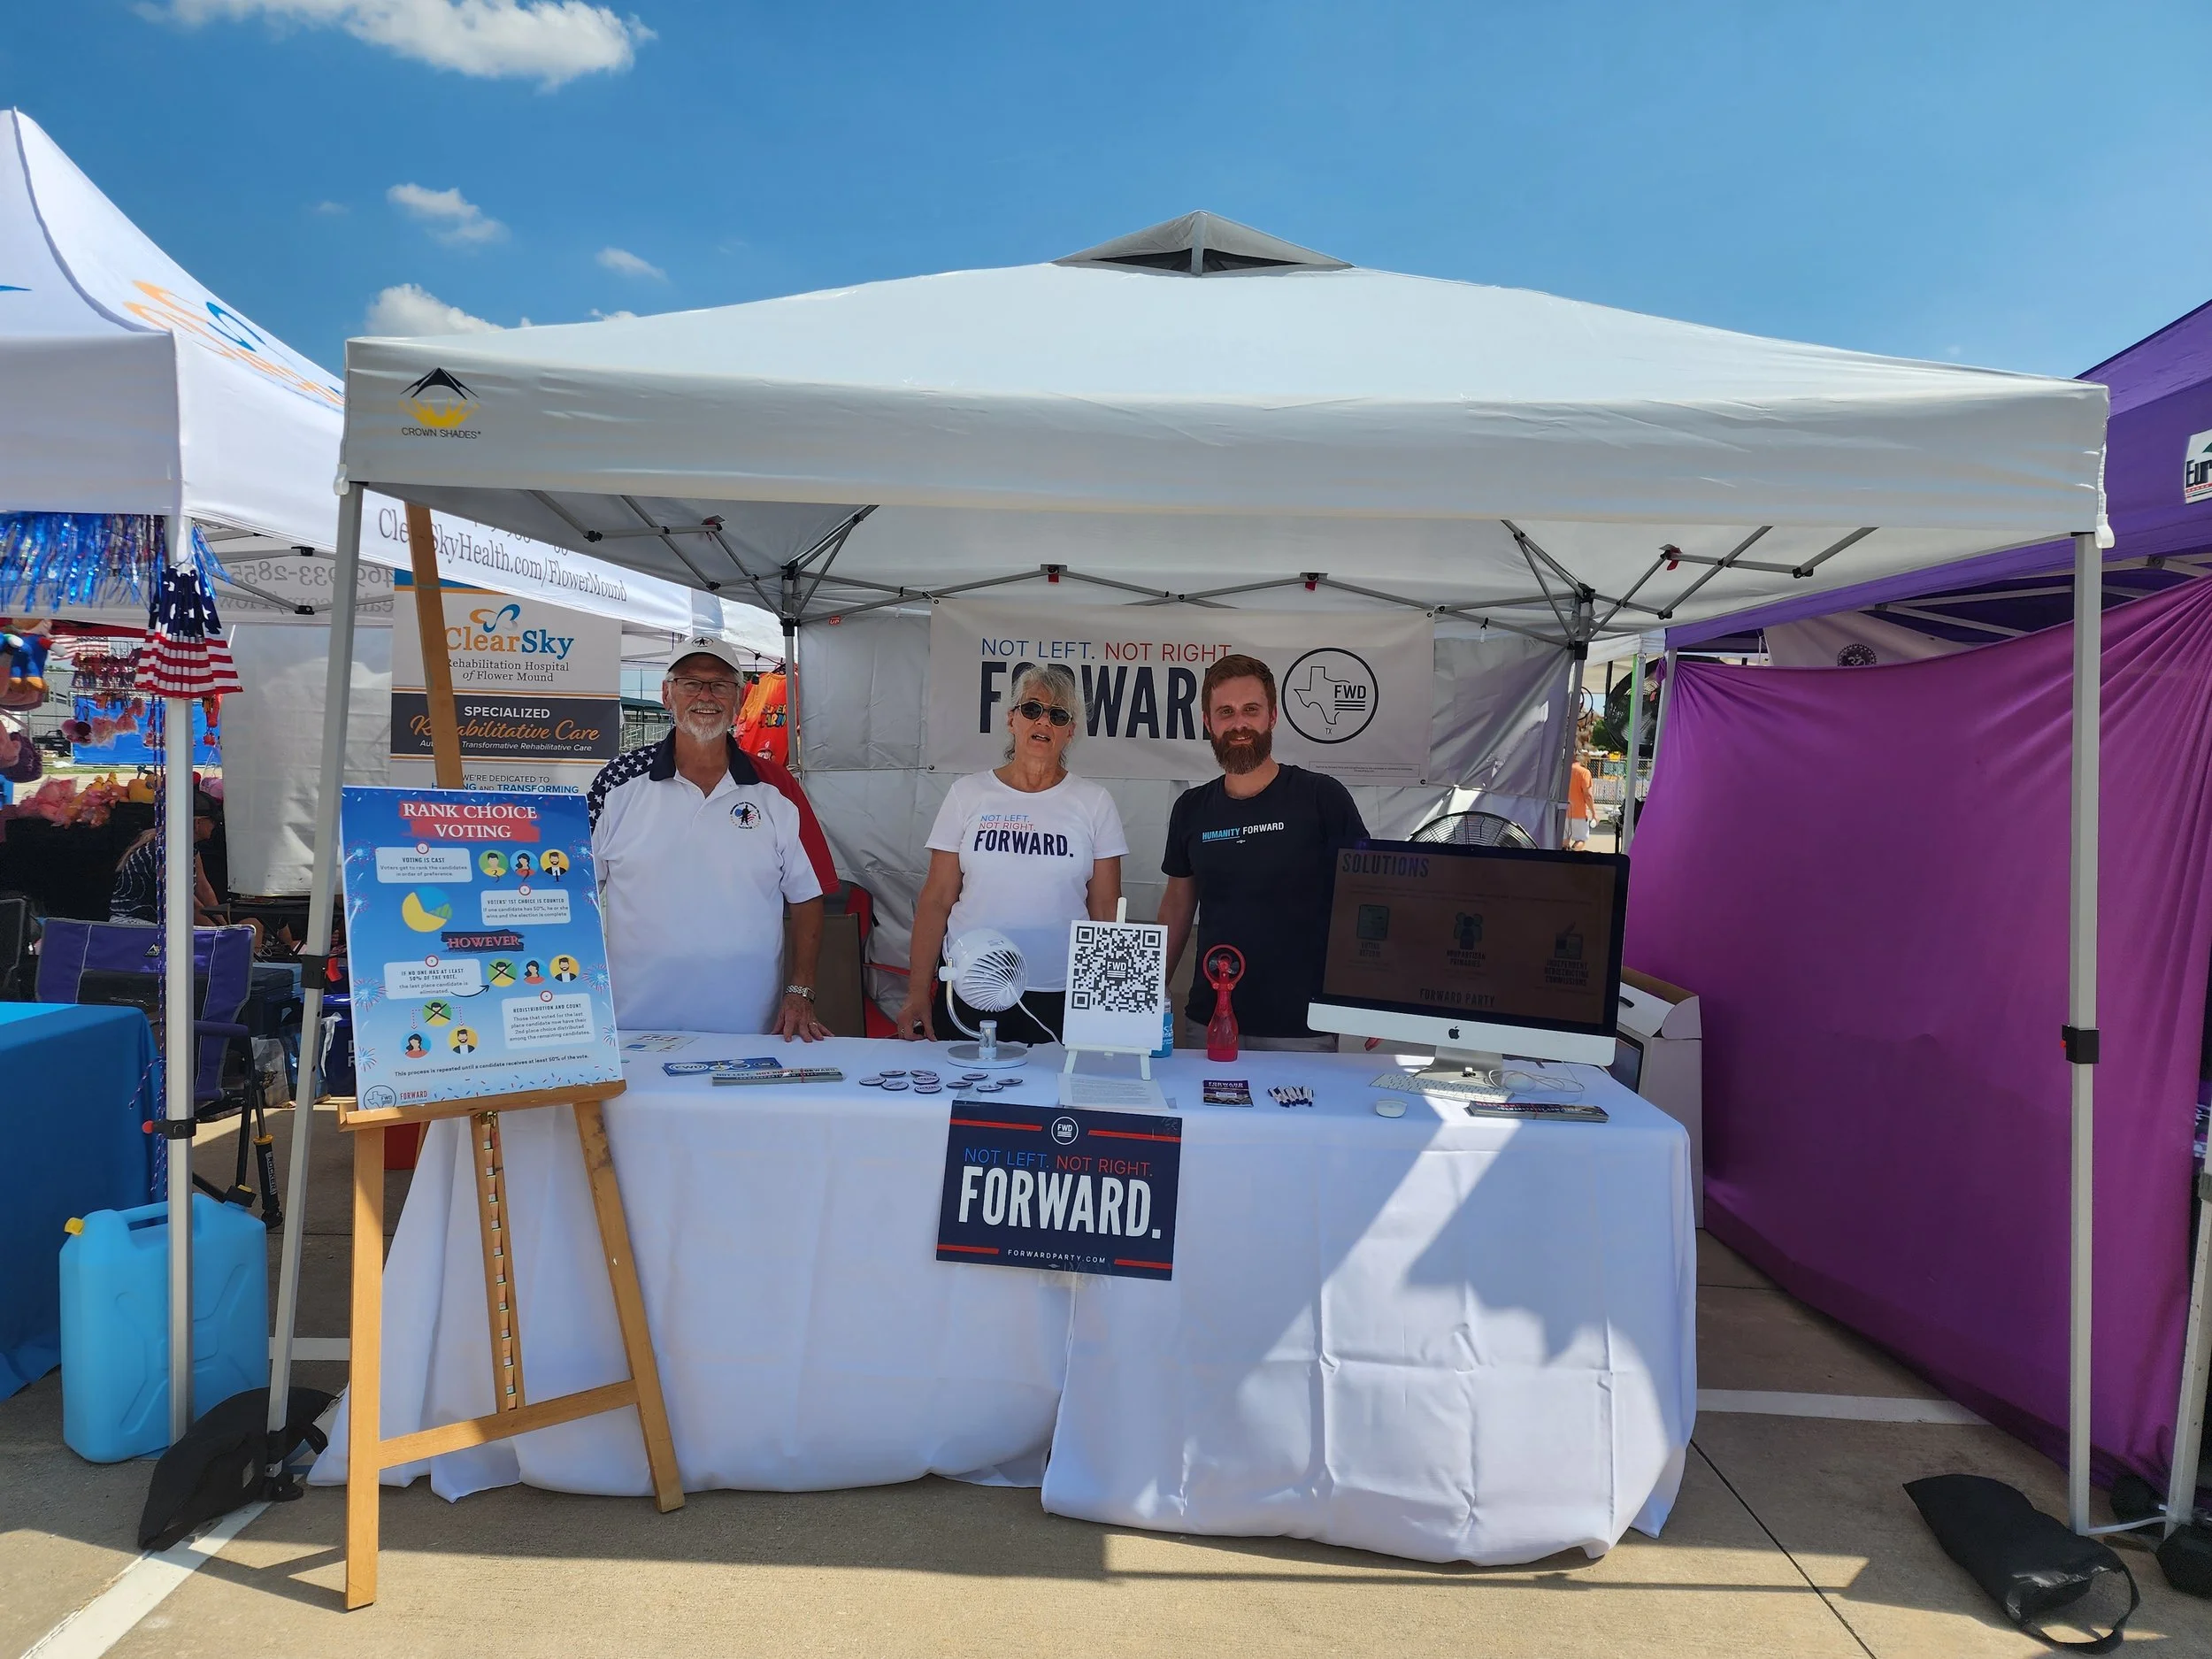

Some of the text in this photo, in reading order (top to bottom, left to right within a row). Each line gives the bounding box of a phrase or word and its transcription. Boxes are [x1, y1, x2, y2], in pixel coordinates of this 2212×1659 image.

[402, 427, 478, 439] CROWN SHADES
[379, 508, 626, 602] CleSkyHealth.com/FlowerMound
[446, 626, 574, 660] ClearSky
[981, 638, 1029, 657] NOT
[1038, 641, 1095, 659] LEFT.
[1105, 642, 1153, 661] NOT
[525, 661, 570, 672] Hospital
[463, 672, 554, 682] of Flower Mound
[1334, 685, 1367, 699] FWD
[979, 662, 1211, 741] FWAR
[464, 706, 550, 718] SPECIALIZED
[410, 715, 601, 741] Rabilitative Care
[462, 741, 519, 750] Transformative
[520, 742, 572, 751] Rehabilitative
[497, 784, 579, 794] TRANSFORMING
[403, 803, 538, 819] RANK CHOICE
[434, 824, 512, 839] VOTING
[1202, 822, 1285, 840] HUMANITY FORWARD
[973, 830, 1074, 857] FORWARD.
[1342, 853, 1430, 878] SOLUTIONS
[448, 936, 519, 949] HOWEVER
[1107, 962, 1127, 972] FWD
[1419, 988, 1495, 1007] FORWARD PARTY
[400, 1091, 427, 1100] FORWARD
[1057, 1124, 1073, 1133] FWD
[964, 1148, 1153, 1177] NOT LEFT. NOT RIGHT.
[958, 1165, 1161, 1239] FORWARD.
[1008, 1248, 1106, 1263] FORWARDPARTY.COM
